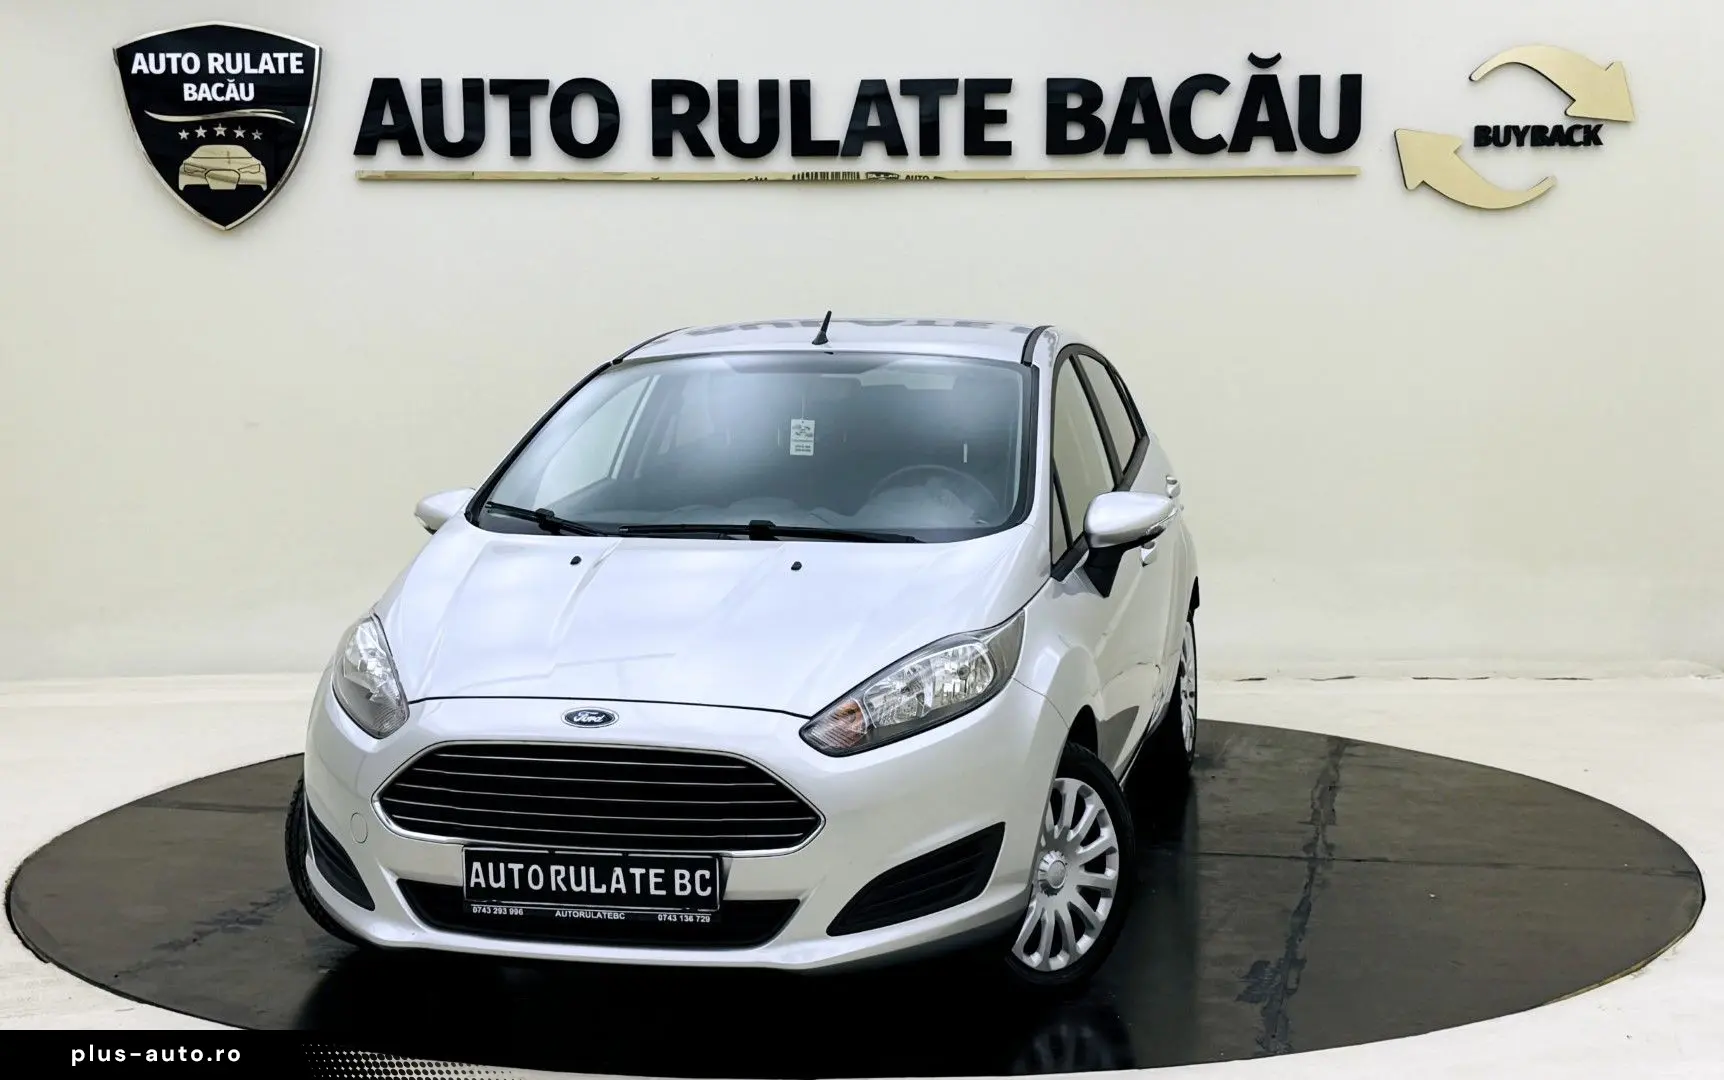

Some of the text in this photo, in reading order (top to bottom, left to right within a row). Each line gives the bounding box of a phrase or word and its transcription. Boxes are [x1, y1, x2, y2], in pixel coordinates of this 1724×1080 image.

[131, 52, 304, 75] AUTO RULATE
[183, 79, 255, 102] BACĂU
[353, 52, 1364, 158] AUTO RULATE BACĂU
[1473, 124, 1604, 148] BUYBACK
[573, 710, 606, 723] Ford
[673, 868, 712, 897] BC
[472, 906, 491, 915] 0743
[493, 907, 507, 916] 293
[555, 910, 626, 920] AUTORULATEBC
[657, 914, 677, 922] 0743
[696, 915, 711, 923] 729
